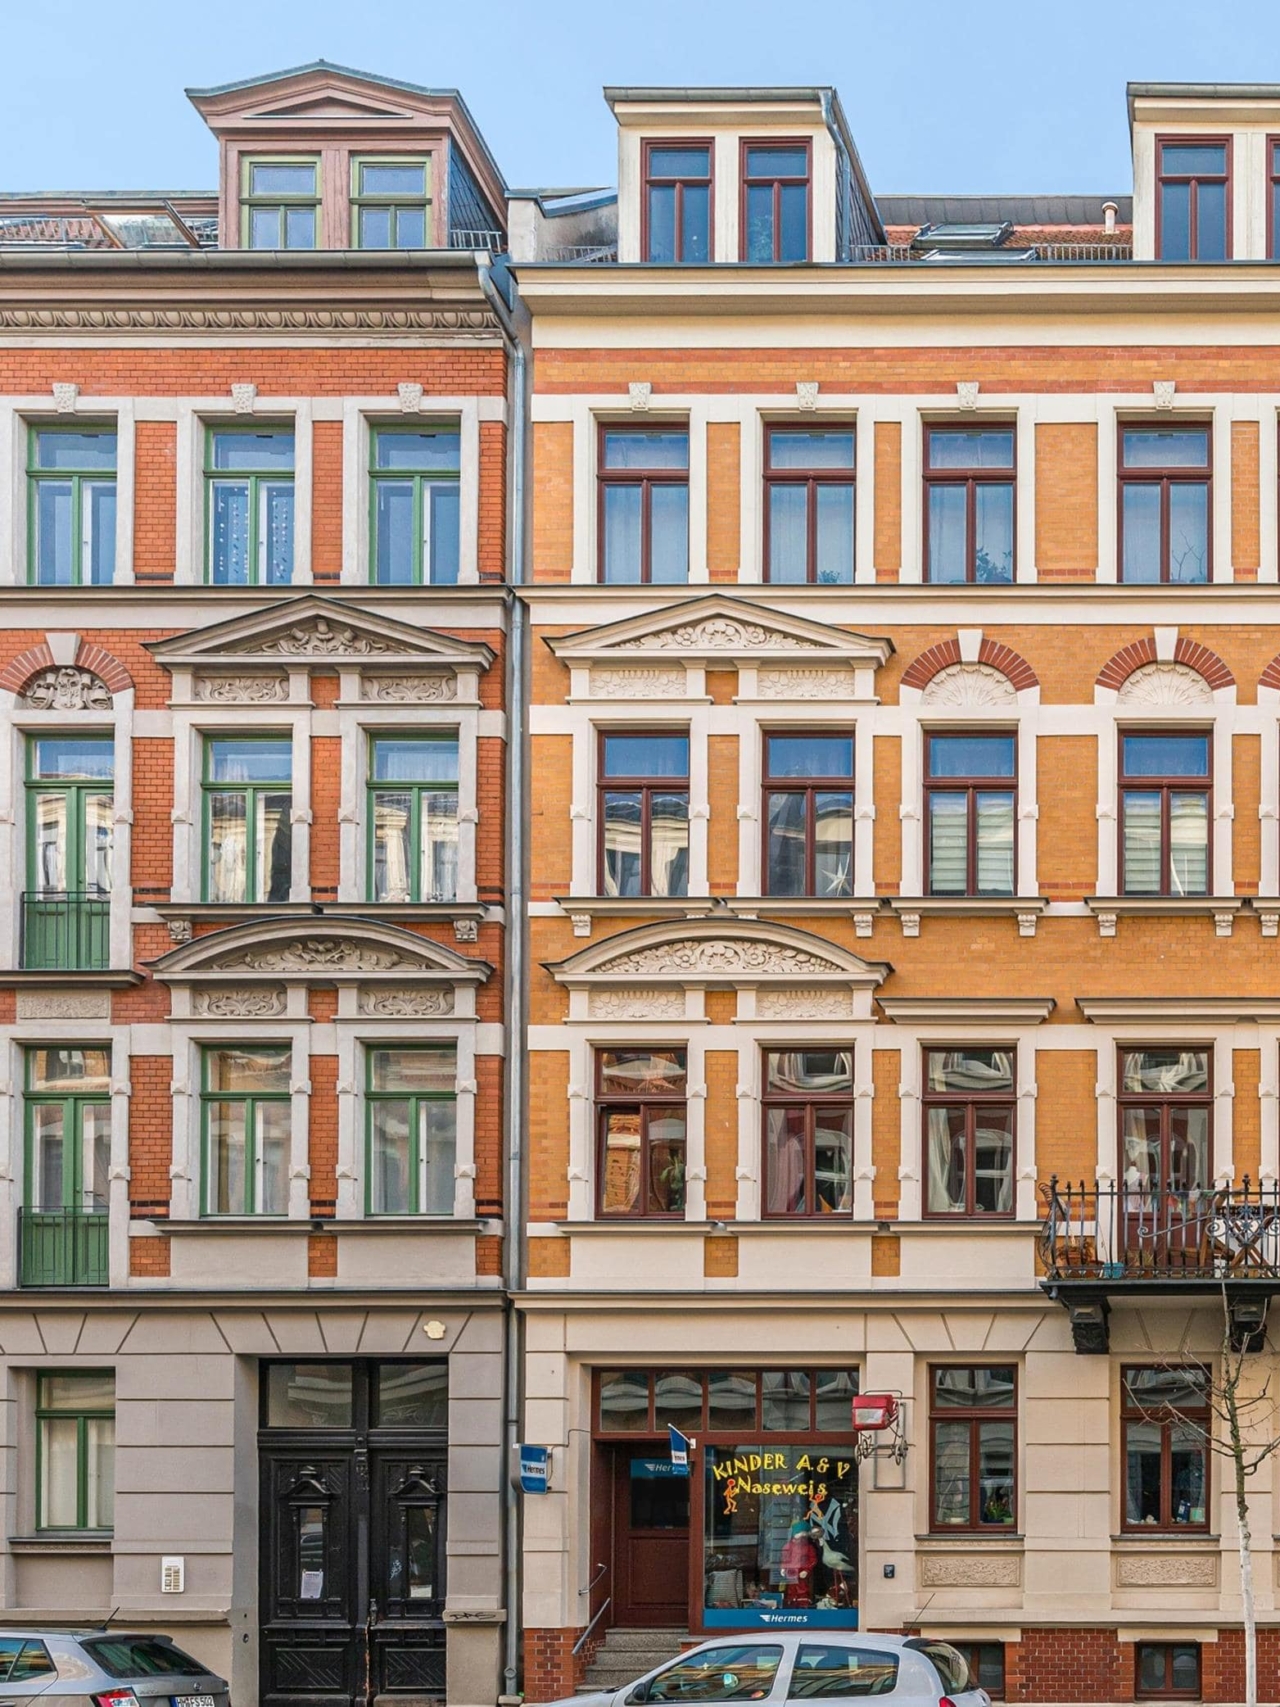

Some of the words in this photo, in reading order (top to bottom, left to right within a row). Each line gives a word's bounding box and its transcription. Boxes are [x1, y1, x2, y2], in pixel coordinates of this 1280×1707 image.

[712, 1453, 788, 1481] KINDER
[817, 1457, 830, 1473] &
[737, 1475, 828, 1495] Naseweis
[771, 1614, 808, 1623] Hermes
